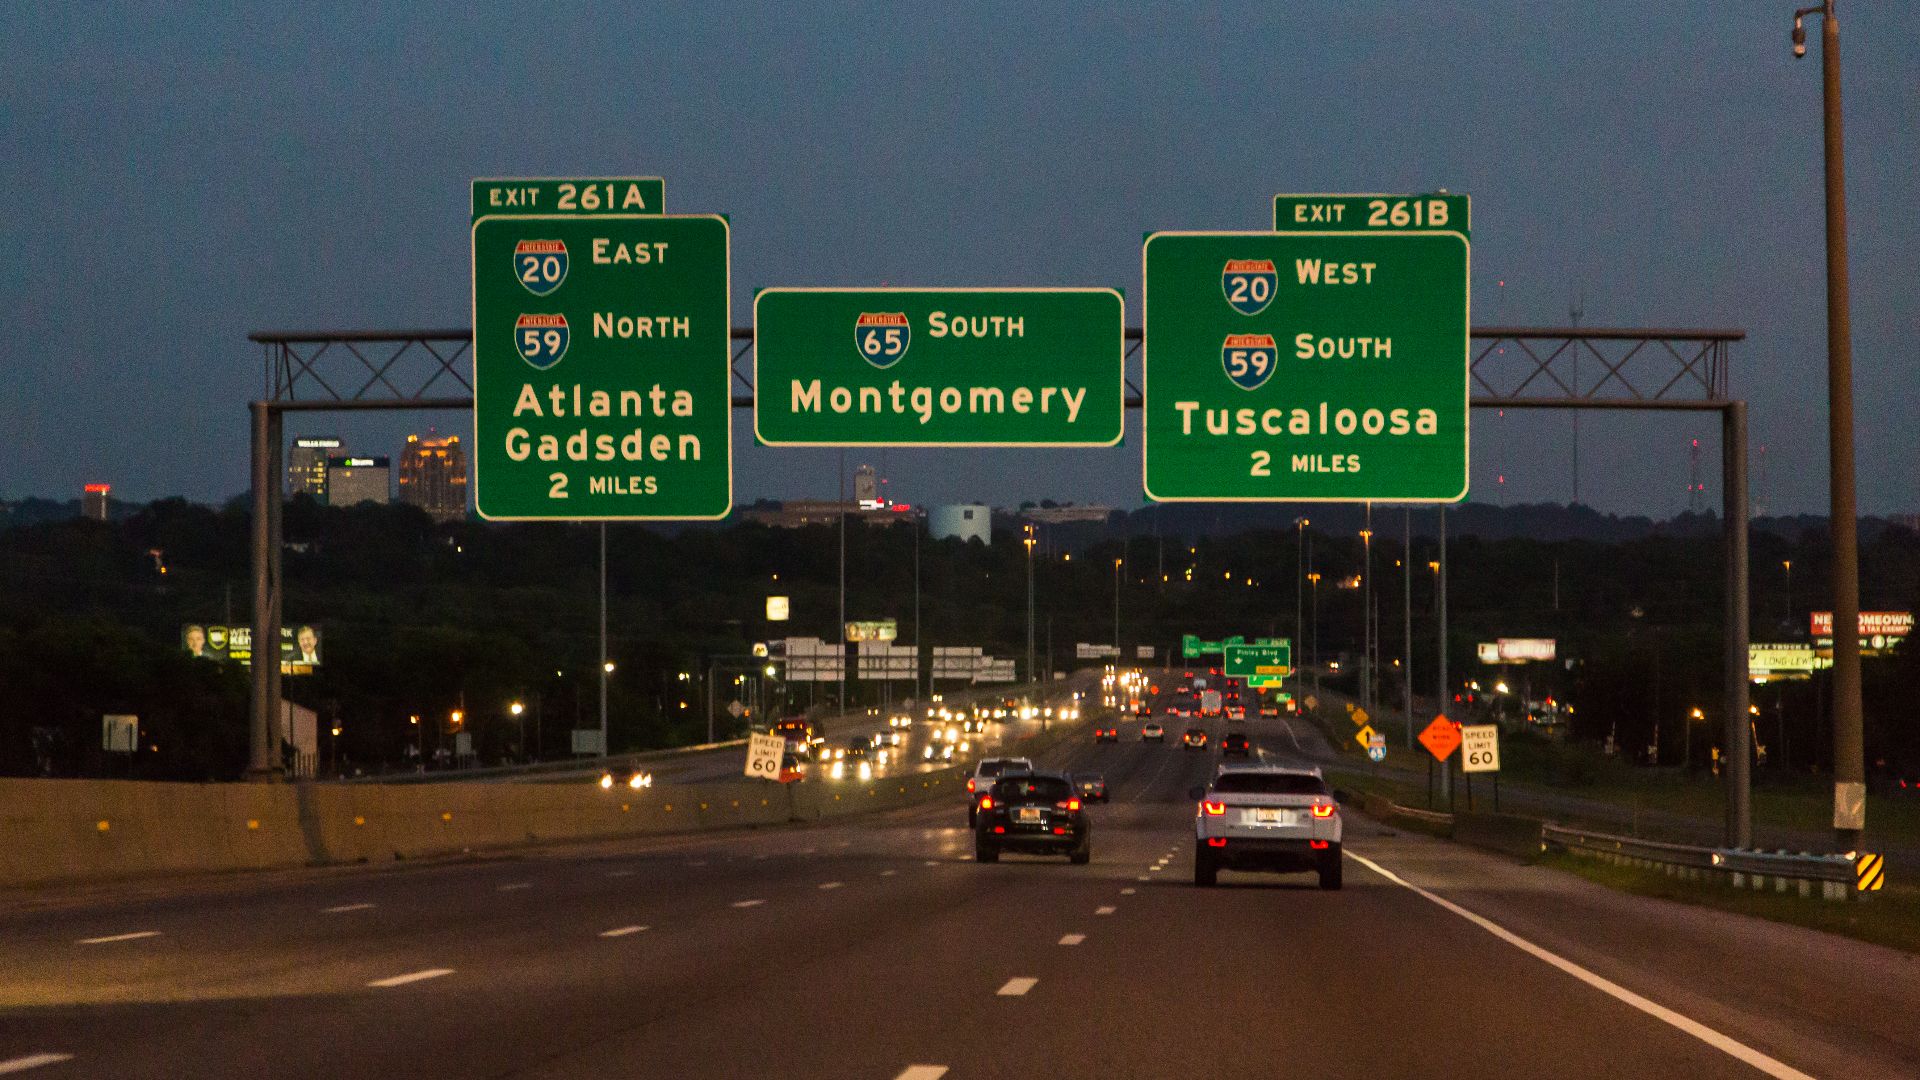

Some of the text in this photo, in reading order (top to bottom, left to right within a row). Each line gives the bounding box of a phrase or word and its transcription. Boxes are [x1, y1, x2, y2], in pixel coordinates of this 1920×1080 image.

[489, 183, 646, 210] EXIT 261A
[1294, 199, 1449, 227] EXIT 261B
[592, 238, 669, 265] EAST
[522, 256, 561, 283] 20
[1295, 258, 1377, 285] WEST
[1230, 276, 1269, 303] 20
[593, 312, 690, 339] NORTH
[928, 310, 1024, 338] SOUTH
[524, 330, 561, 357] 59
[864, 329, 902, 355] 65
[1295, 333, 1392, 360] SOUTH
[1230, 350, 1269, 378] 59
[512, 383, 693, 418] Atlanta
[791, 379, 1087, 425] Montgomery
[1174, 401, 1438, 436] Tuscaloosa
[505, 427, 701, 462] Gadsden
[1250, 450, 1361, 477] 2 MILES
[548, 472, 658, 499] 2 MILES
[753, 737, 783, 749] SPEED
[1464, 730, 1495, 740] SPEED
[1468, 742, 1492, 750] LIMIT
[752, 757, 777, 774] 60
[754, 748, 777, 758] LIMIT
[1469, 750, 1494, 766] 60
